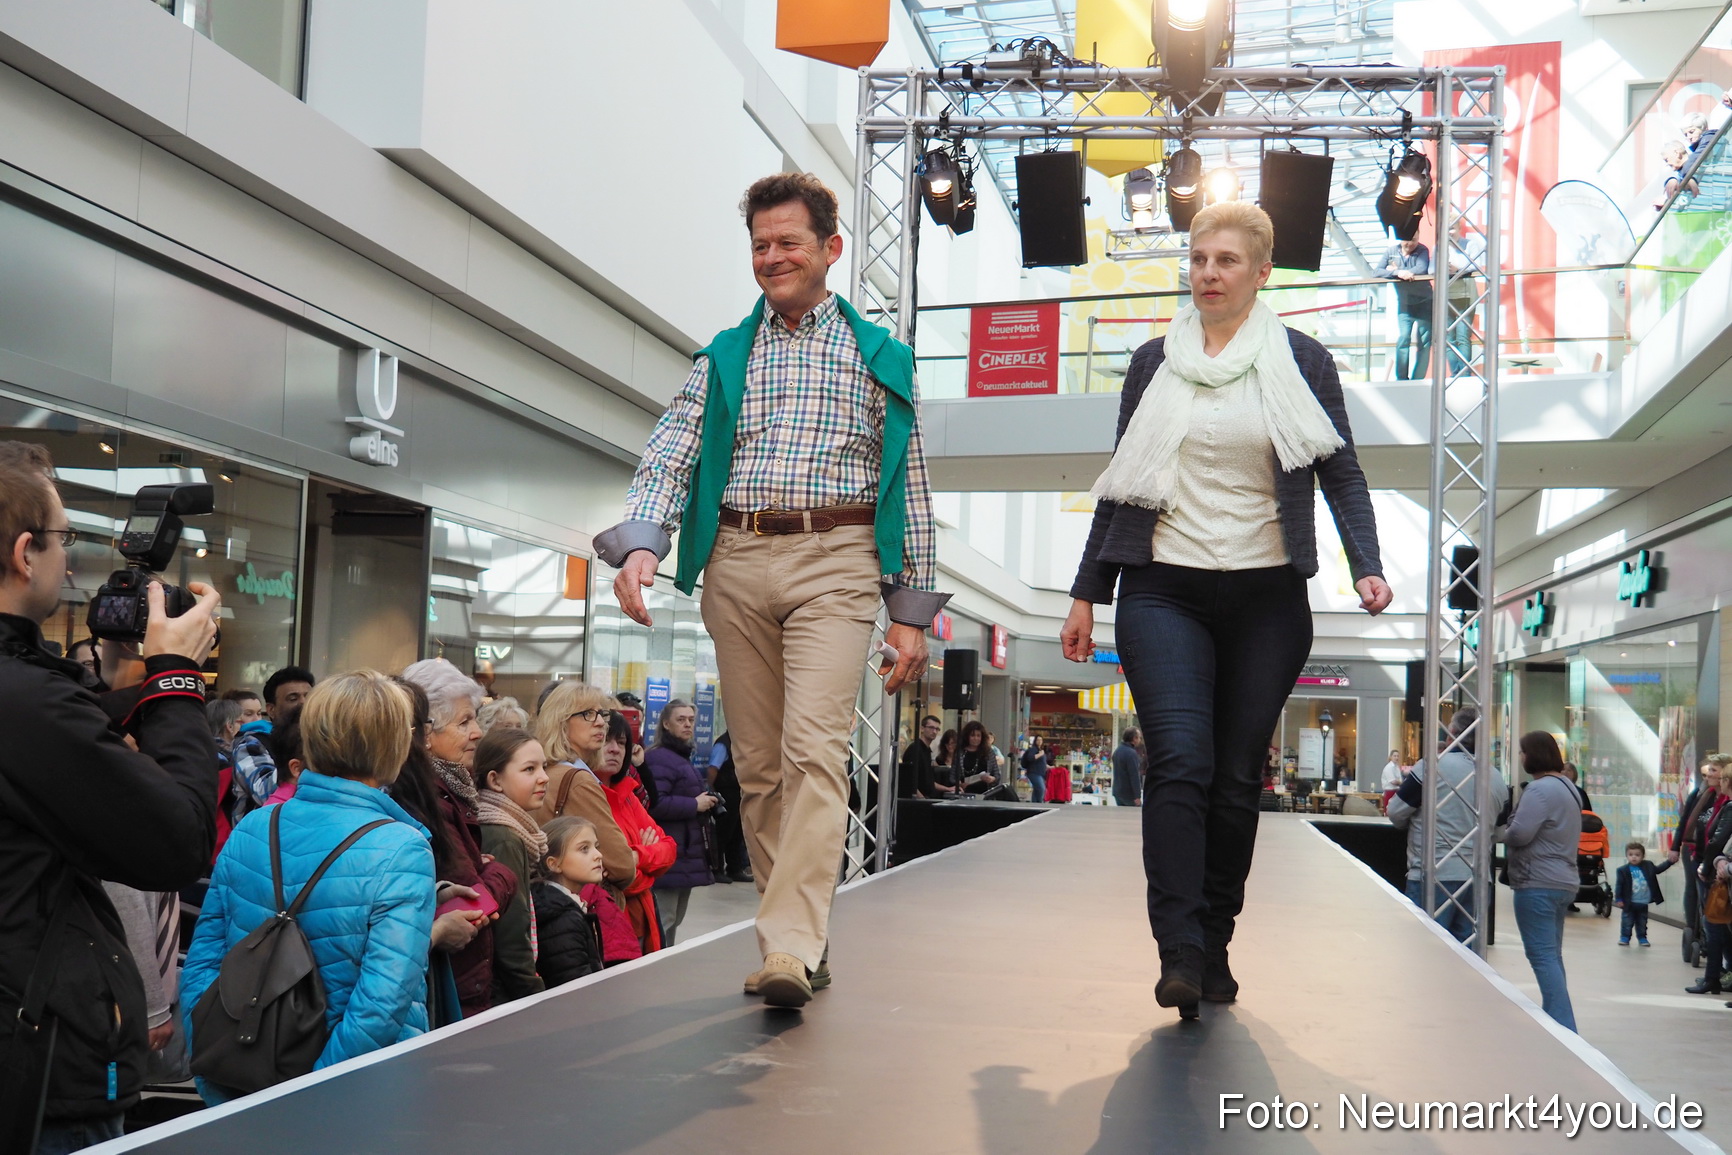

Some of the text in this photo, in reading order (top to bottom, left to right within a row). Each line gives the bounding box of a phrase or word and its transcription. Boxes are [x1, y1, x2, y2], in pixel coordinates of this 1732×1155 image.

[988, 324, 1040, 334] NeuerMarkt
[365, 348, 398, 420] U
[358, 430, 399, 467] eins
[158, 676, 196, 690] EOS
